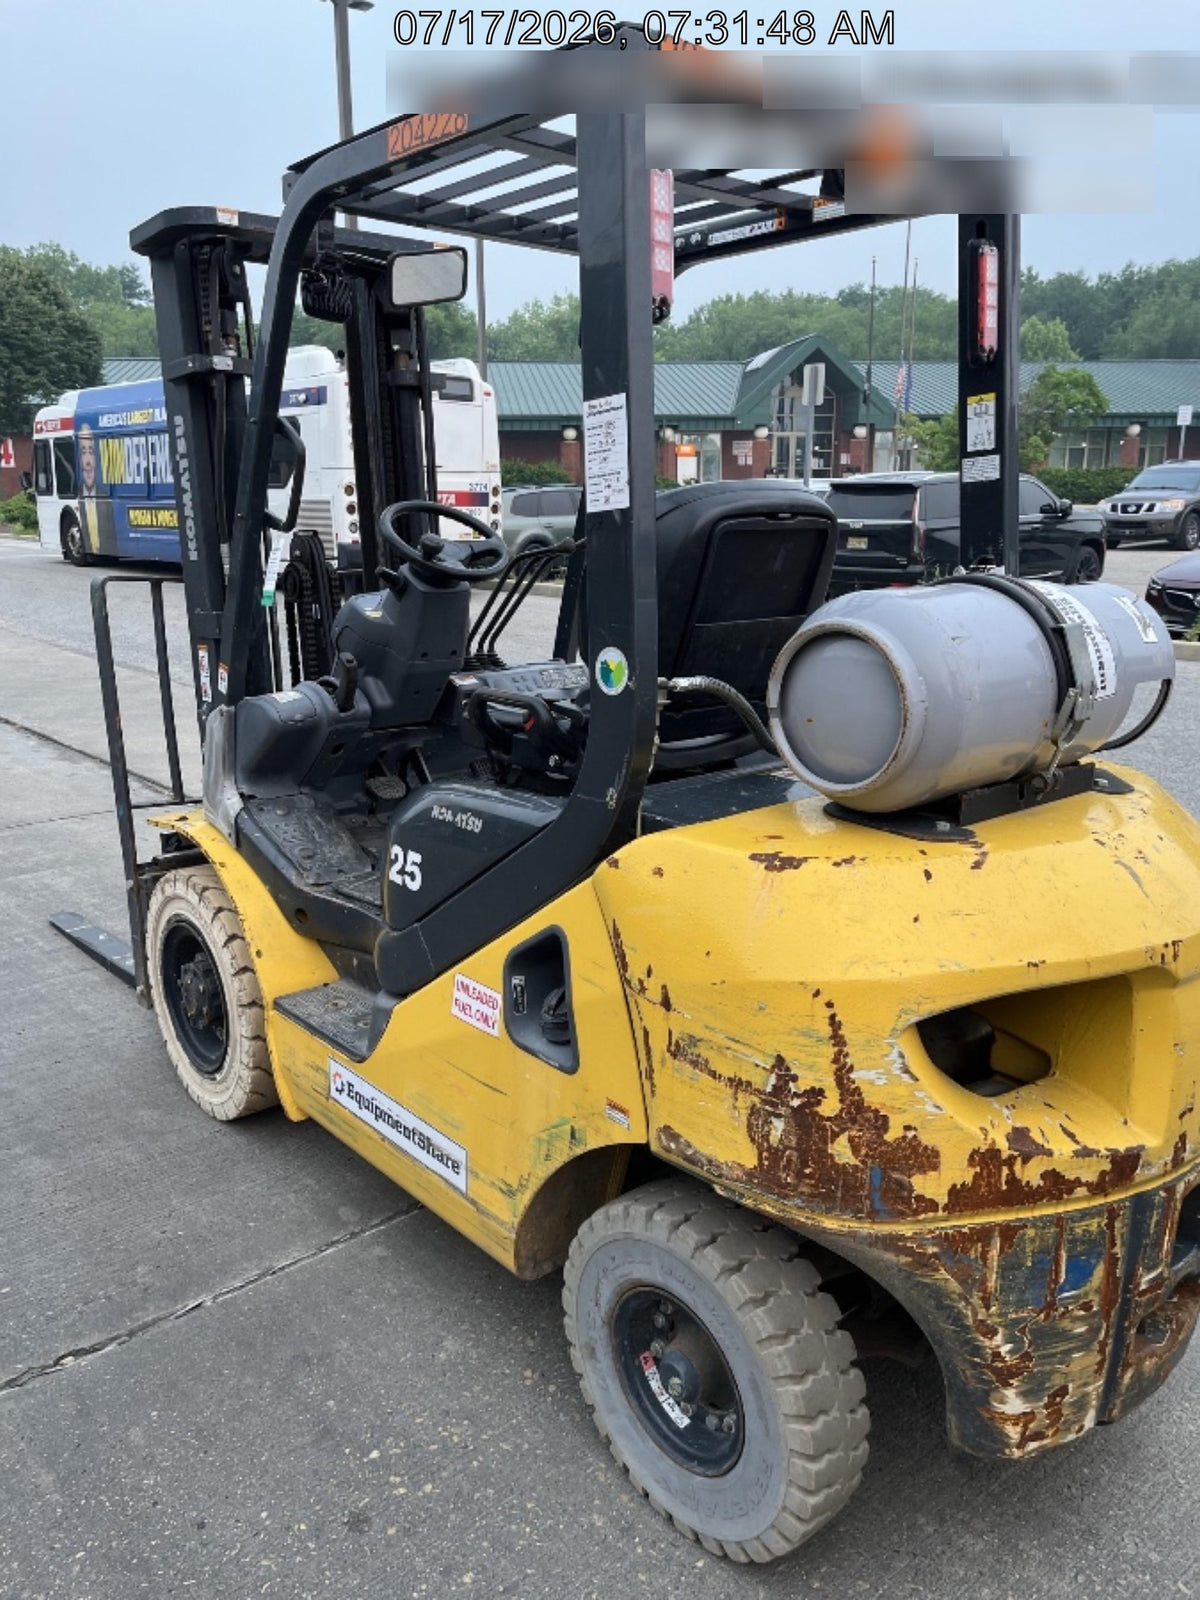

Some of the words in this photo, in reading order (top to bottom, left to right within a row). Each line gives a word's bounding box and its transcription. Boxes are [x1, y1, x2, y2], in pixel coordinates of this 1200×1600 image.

[173, 415, 198, 561] KOMATSU
[388, 843, 423, 892] 25
[454, 997, 474, 1019] FUEL
[475, 1008, 497, 1031] ONLY
[456, 979, 499, 1011] UNLEADED
[346, 1081, 460, 1175] EquipmentShare
